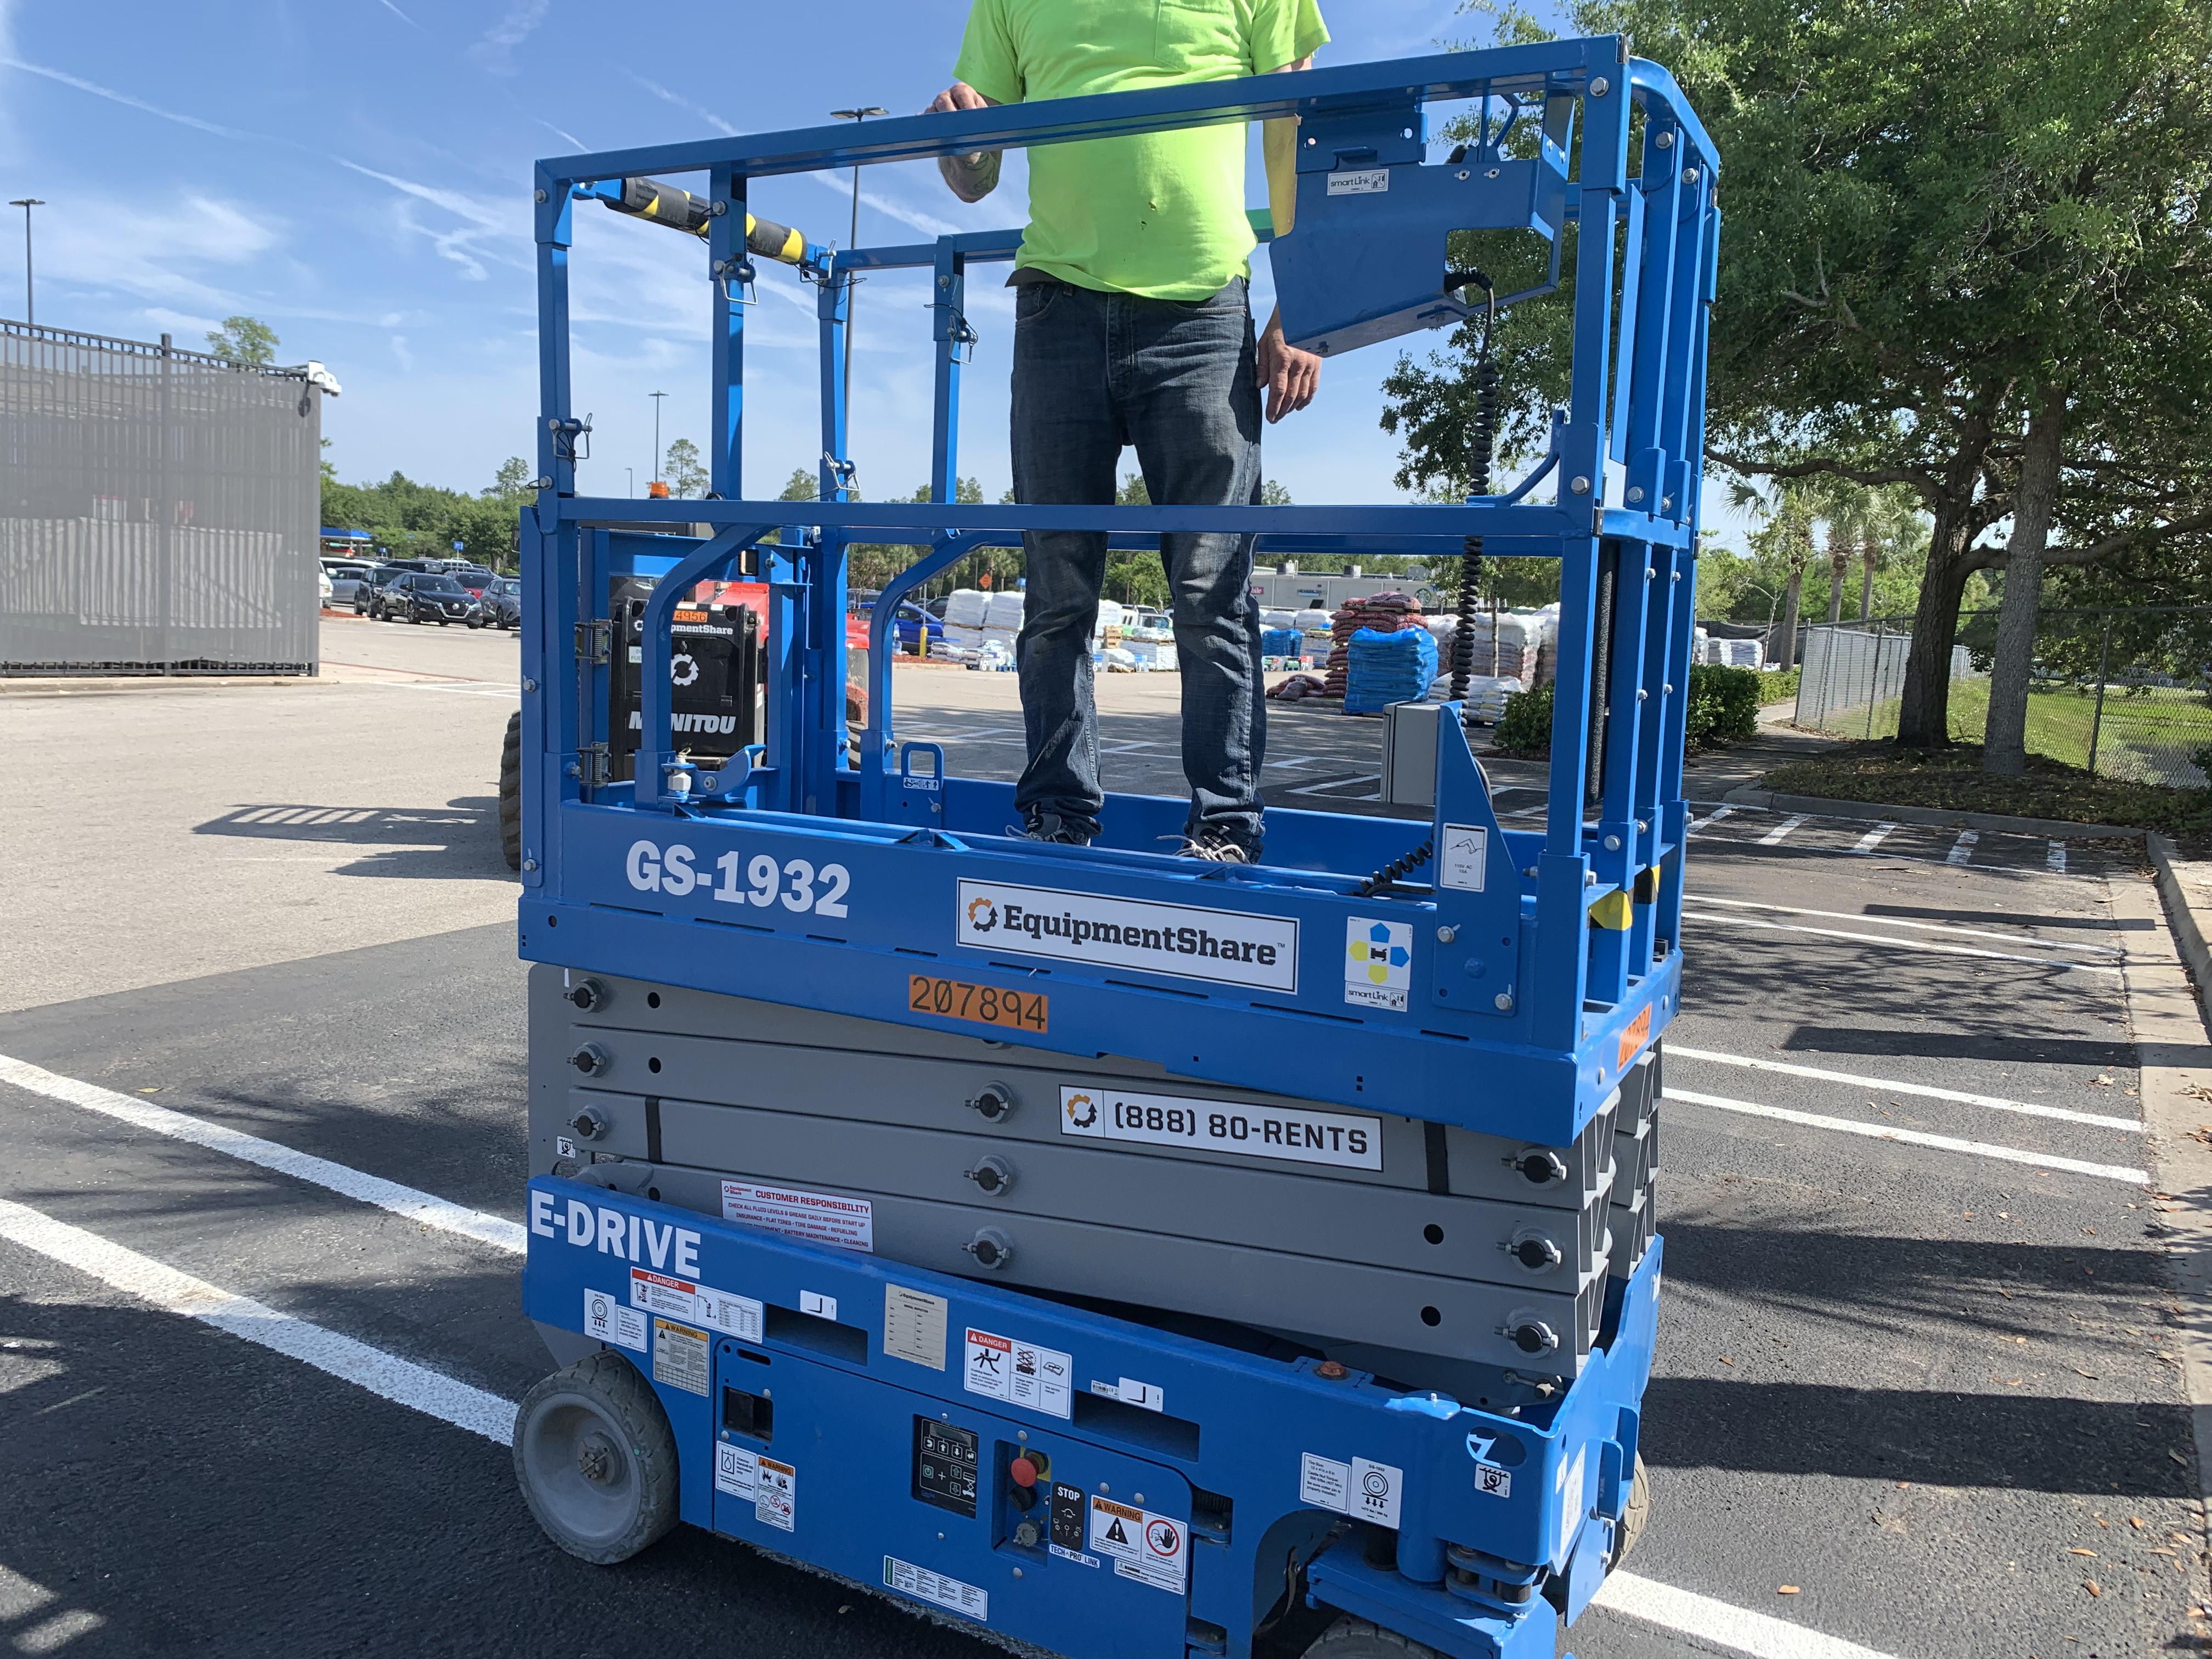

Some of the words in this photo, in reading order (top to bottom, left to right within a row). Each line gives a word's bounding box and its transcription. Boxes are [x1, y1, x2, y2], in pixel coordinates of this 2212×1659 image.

[675, 611, 707, 621] 4956
[671, 624, 733, 635] pmentShare
[629, 711, 736, 733] MNITOU
[626, 840, 850, 918] GS-1932
[911, 976, 1046, 1030] 207894
[1115, 1102, 1195, 1137] (888)
[1209, 1114, 1367, 1154] 80-RENTS
[756, 1190, 799, 1203] CUSTOMER
[801, 1197, 869, 1214] RESPONSIBILITY
[736, 1212, 762, 1221] INSURANCE
[831, 1227, 857, 1236] REFUELING
[531, 1189, 701, 1280] E-DRIVE
[805, 1232, 840, 1242] MAINTENANCE
[844, 1238, 868, 1247] CLEANING
[653, 1274, 680, 1289] DANGER
[670, 1325, 698, 1339] WARNING
[979, 1336, 1007, 1349] DANGER
[768, 1460, 791, 1475] WARNING
[1057, 1486, 1080, 1502] STOP
[1104, 1503, 1141, 1521] WARNING
[1051, 1545, 1065, 1556] TECH
[1085, 1557, 1098, 1568] LINK
